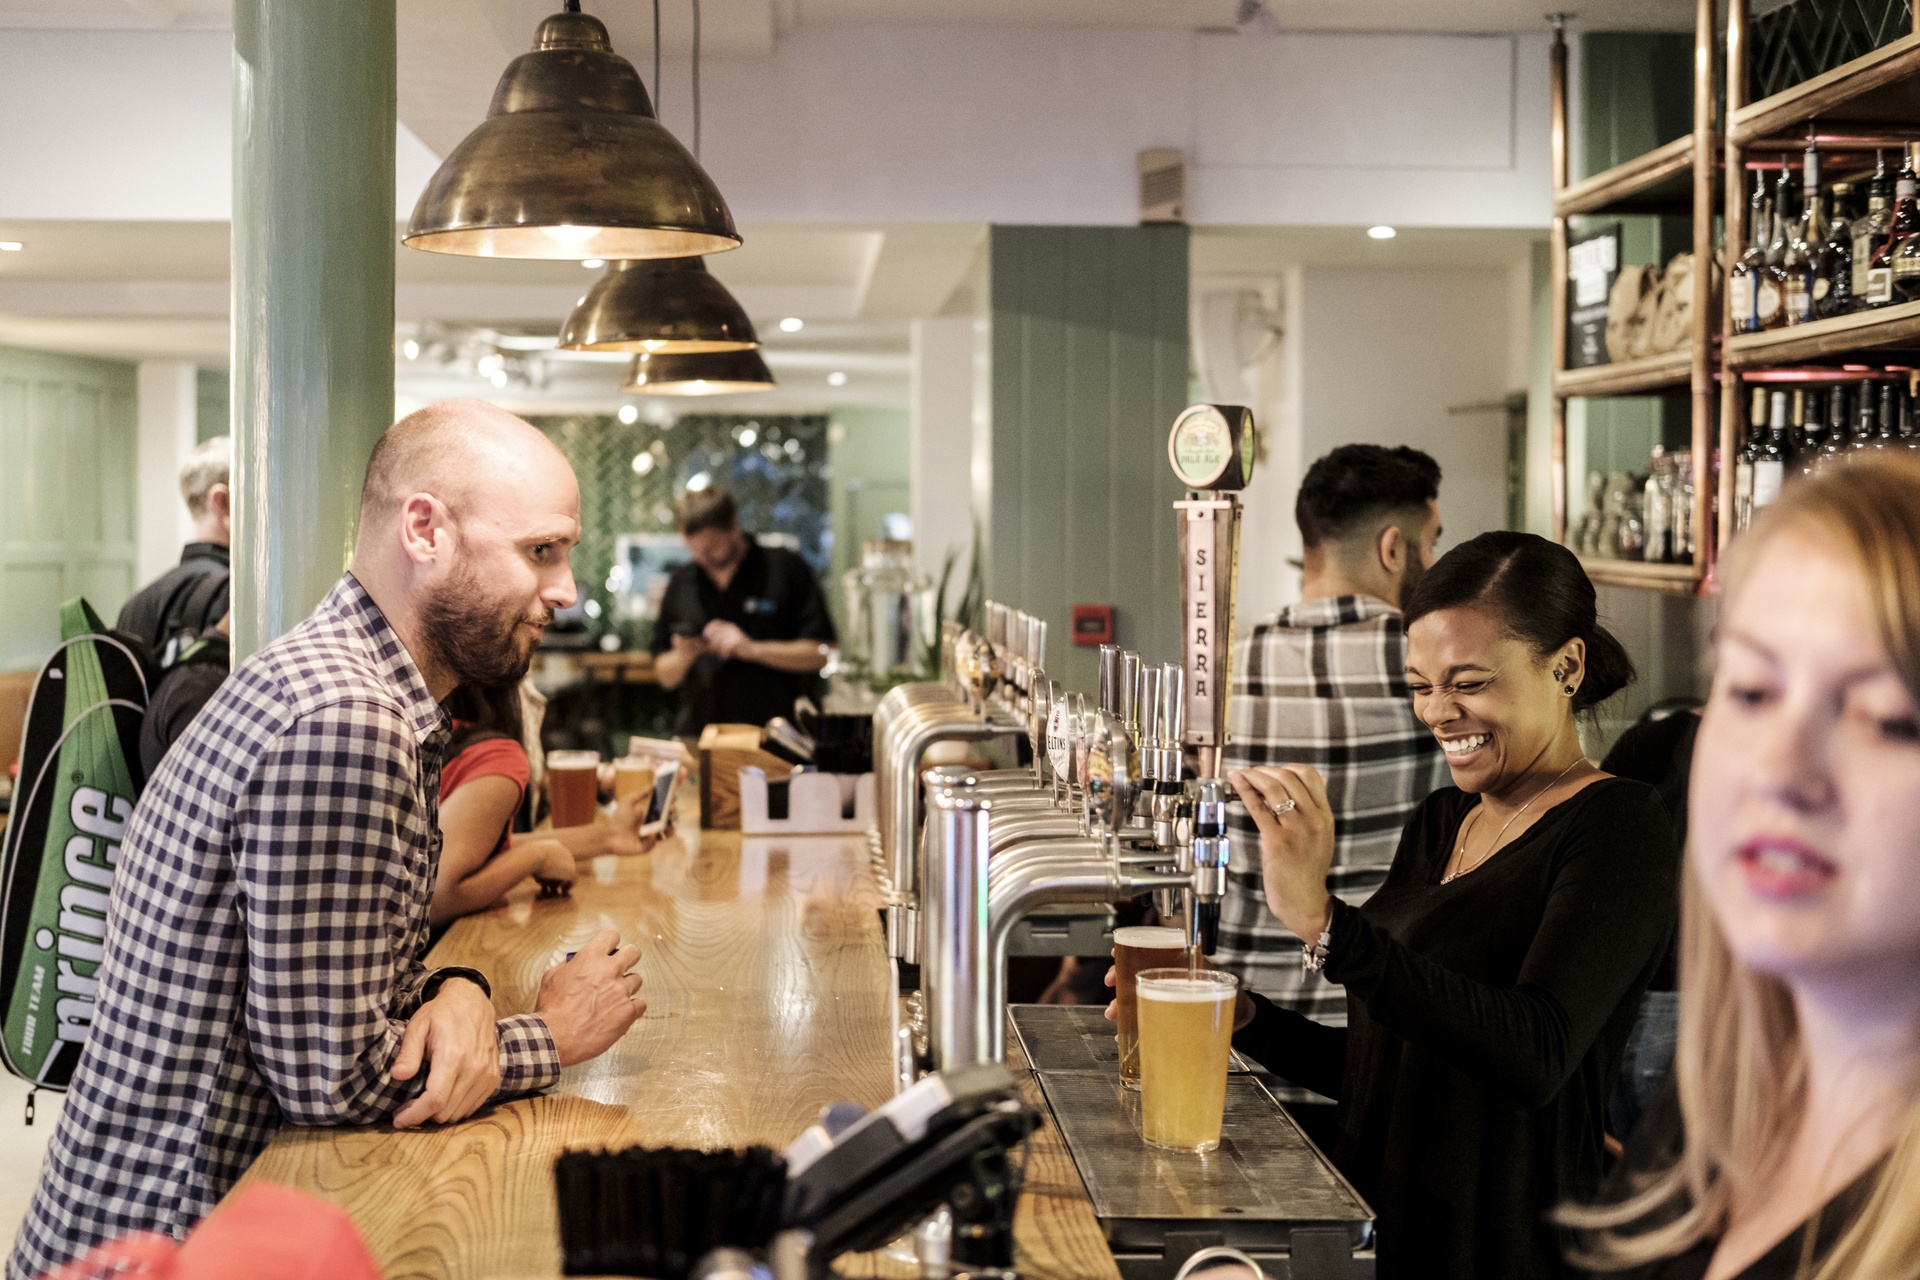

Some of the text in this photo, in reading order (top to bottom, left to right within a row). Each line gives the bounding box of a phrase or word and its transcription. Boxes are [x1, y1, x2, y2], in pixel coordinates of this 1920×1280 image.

[1195, 548, 1207, 698] SIERRA
[1047, 735, 1066, 750] ELTINS
[22, 964, 46, 1055] TOUR TEAM
